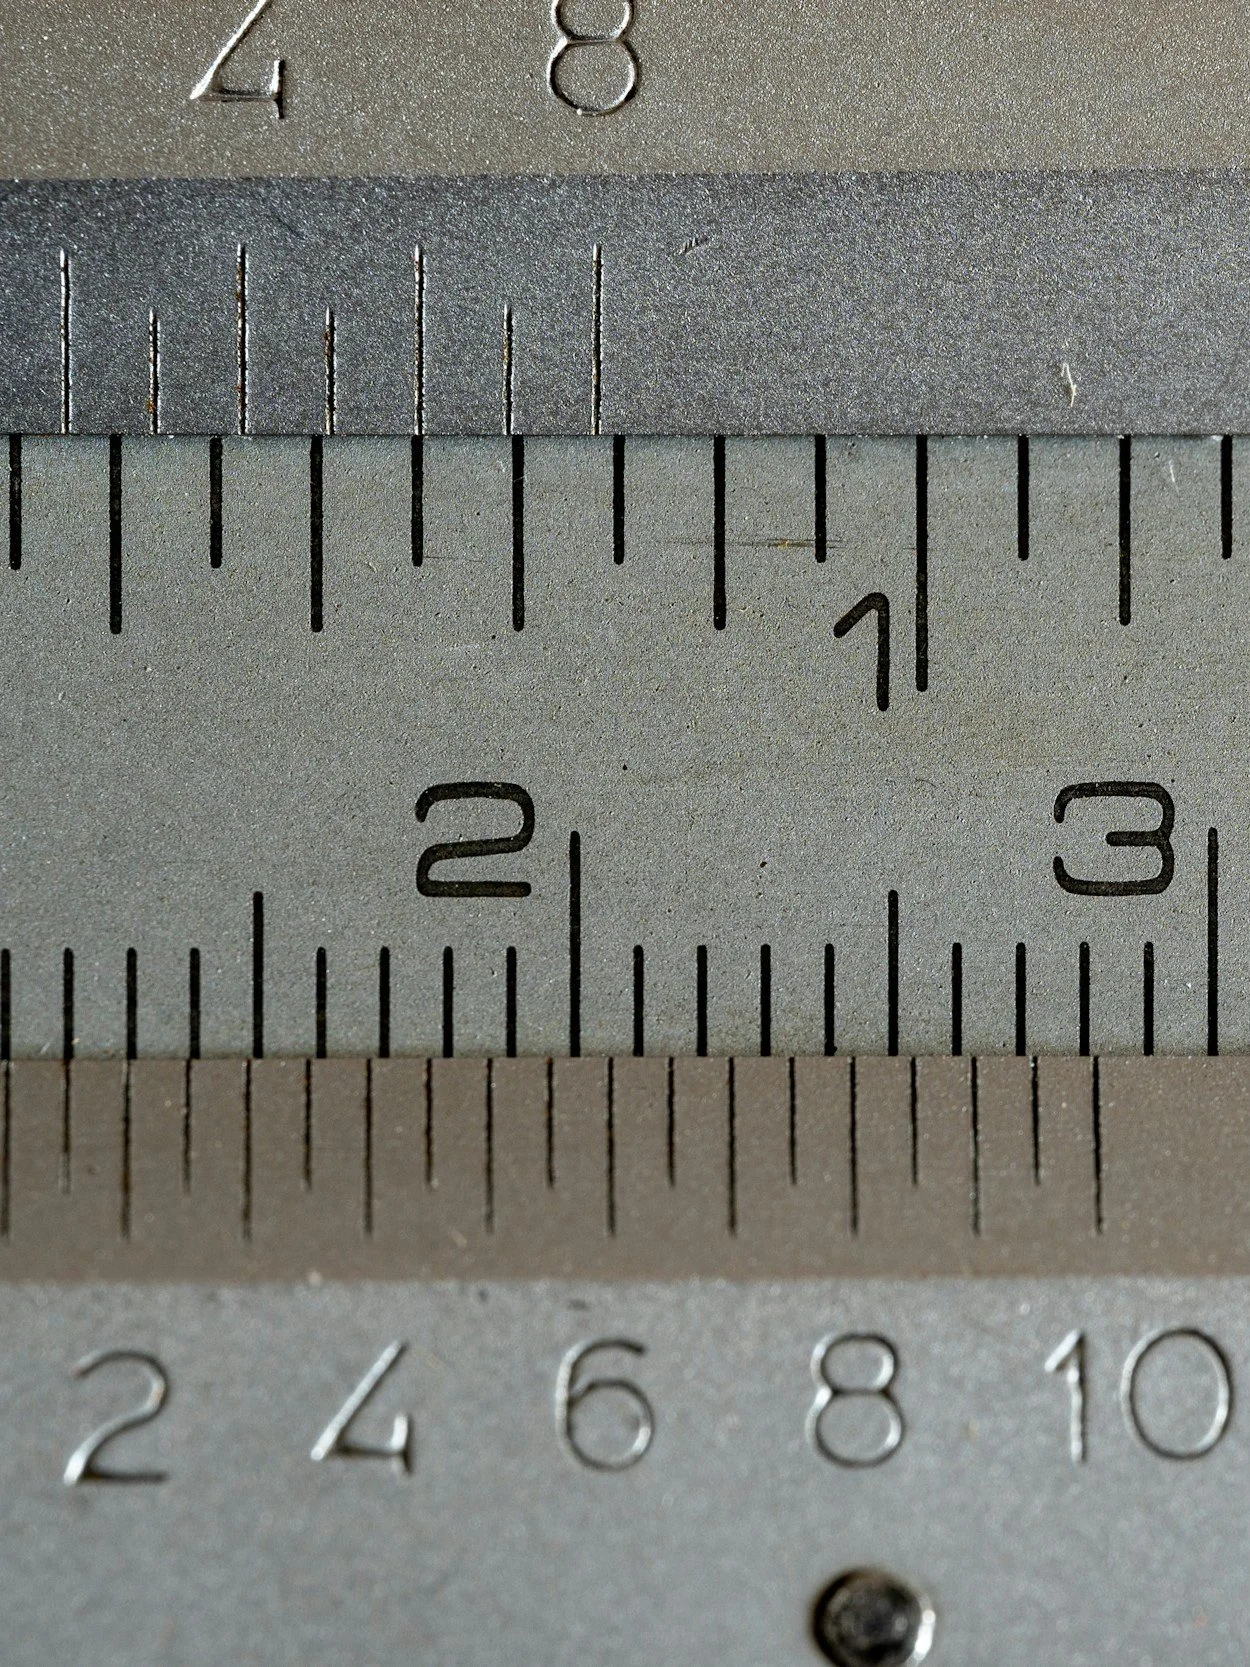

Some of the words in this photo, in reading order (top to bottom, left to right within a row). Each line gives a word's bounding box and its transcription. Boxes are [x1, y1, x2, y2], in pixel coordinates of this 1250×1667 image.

[190, 0, 285, 119] 4
[547, 0, 639, 115] 8
[833, 592, 889, 712] 1
[415, 782, 536, 898] 2
[1053, 780, 1176, 897] 3
[63, 1348, 170, 1486] 2
[310, 1340, 413, 1476] 4
[554, 1336, 655, 1472] 6
[805, 1333, 905, 1469] 8
[1044, 1327, 1234, 1462] 10
